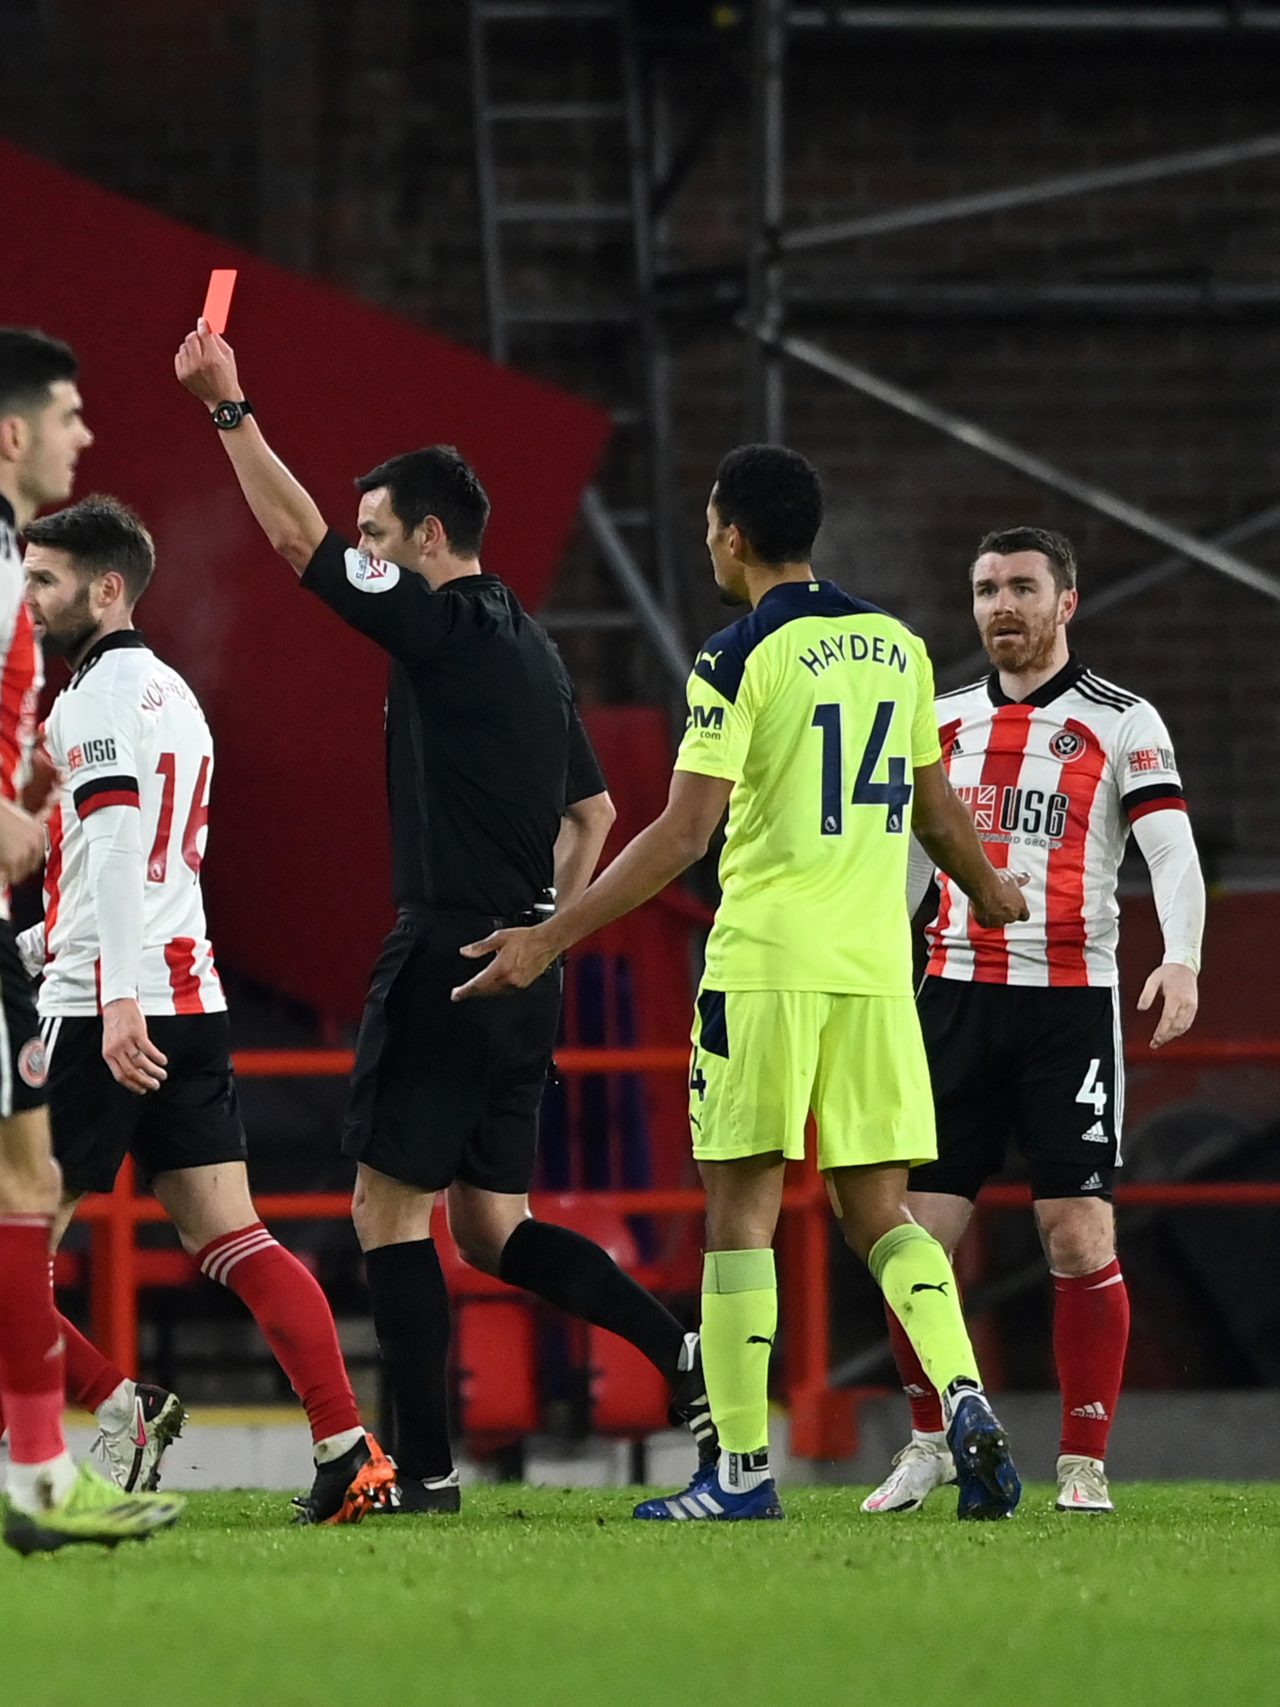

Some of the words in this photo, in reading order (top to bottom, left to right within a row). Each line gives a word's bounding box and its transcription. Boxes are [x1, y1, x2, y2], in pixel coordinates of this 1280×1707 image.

[798, 633, 907, 678] HAYDEN
[83, 738, 117, 764] USG
[810, 700, 913, 836] 14
[146, 751, 211, 884] 16
[999, 785, 1070, 839] USG
[1074, 1058, 1108, 1116] 4
